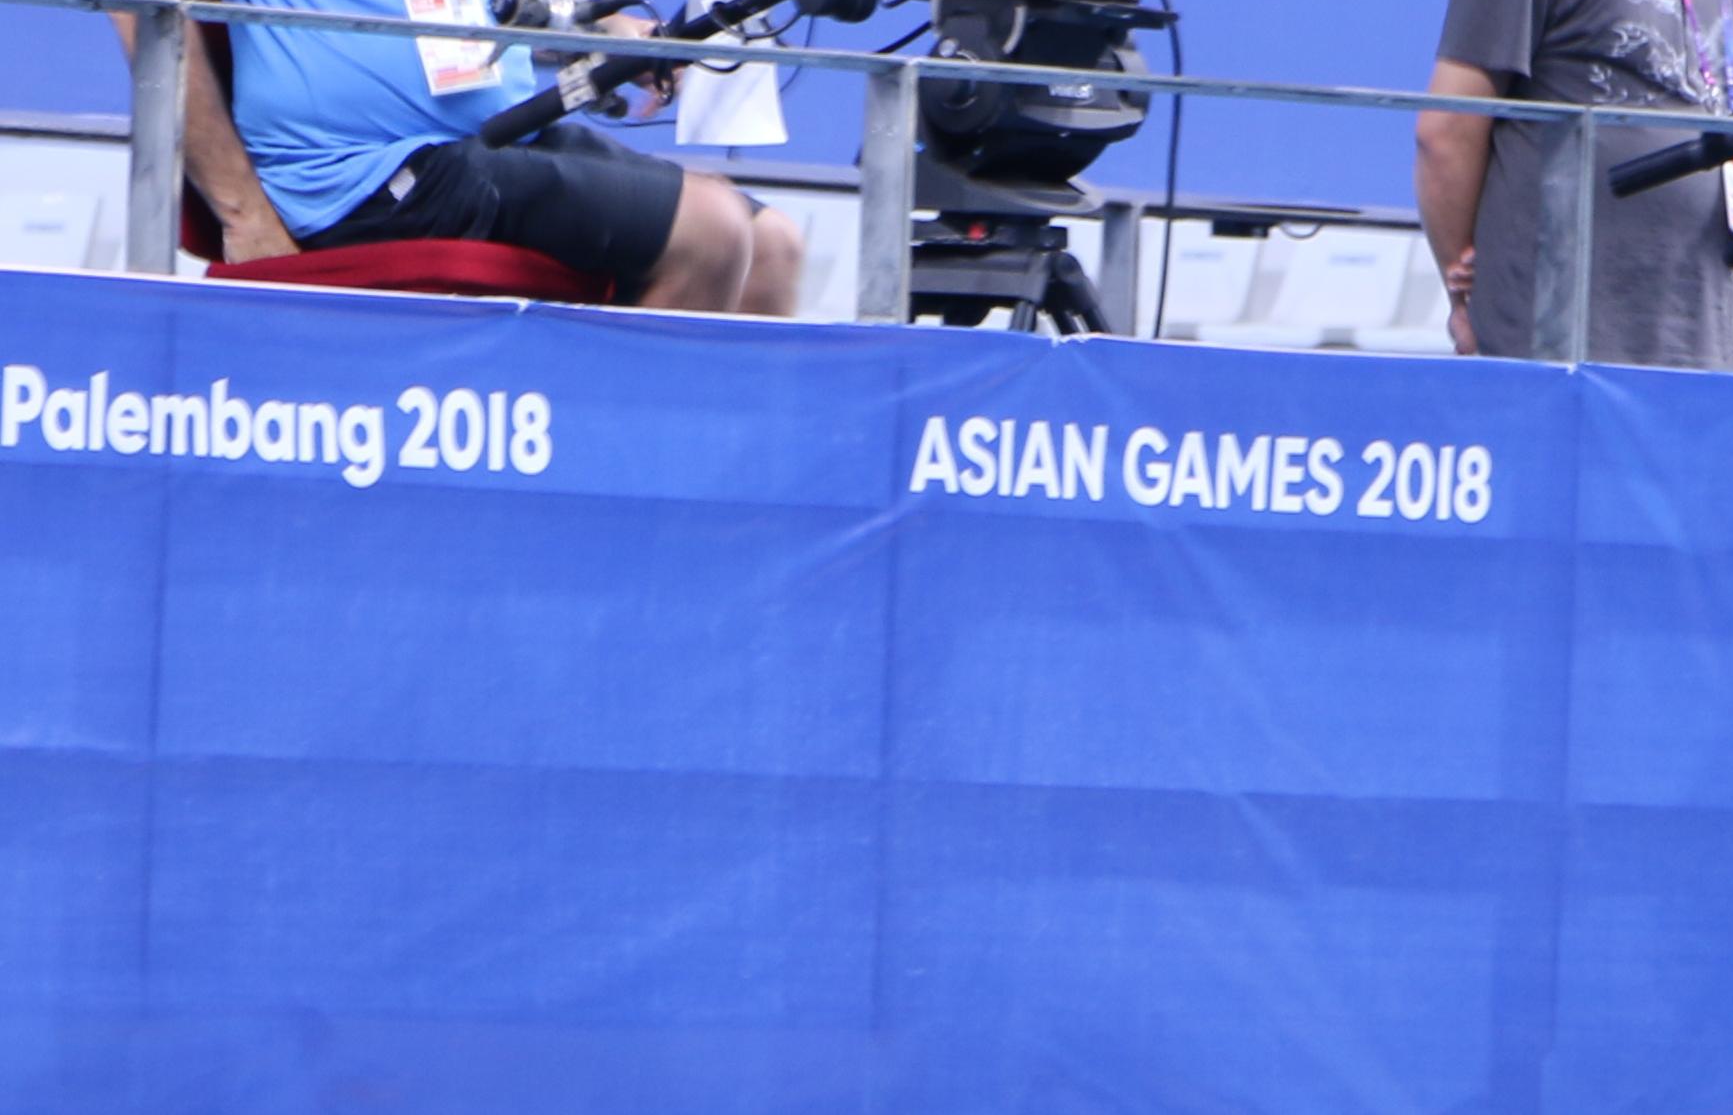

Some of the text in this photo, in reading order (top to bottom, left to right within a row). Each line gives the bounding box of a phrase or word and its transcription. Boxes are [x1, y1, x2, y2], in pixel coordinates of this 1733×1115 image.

[0, 364, 552, 488] Palembang 2018
[909, 416, 1492, 523] ASIAN GAMES 2018
